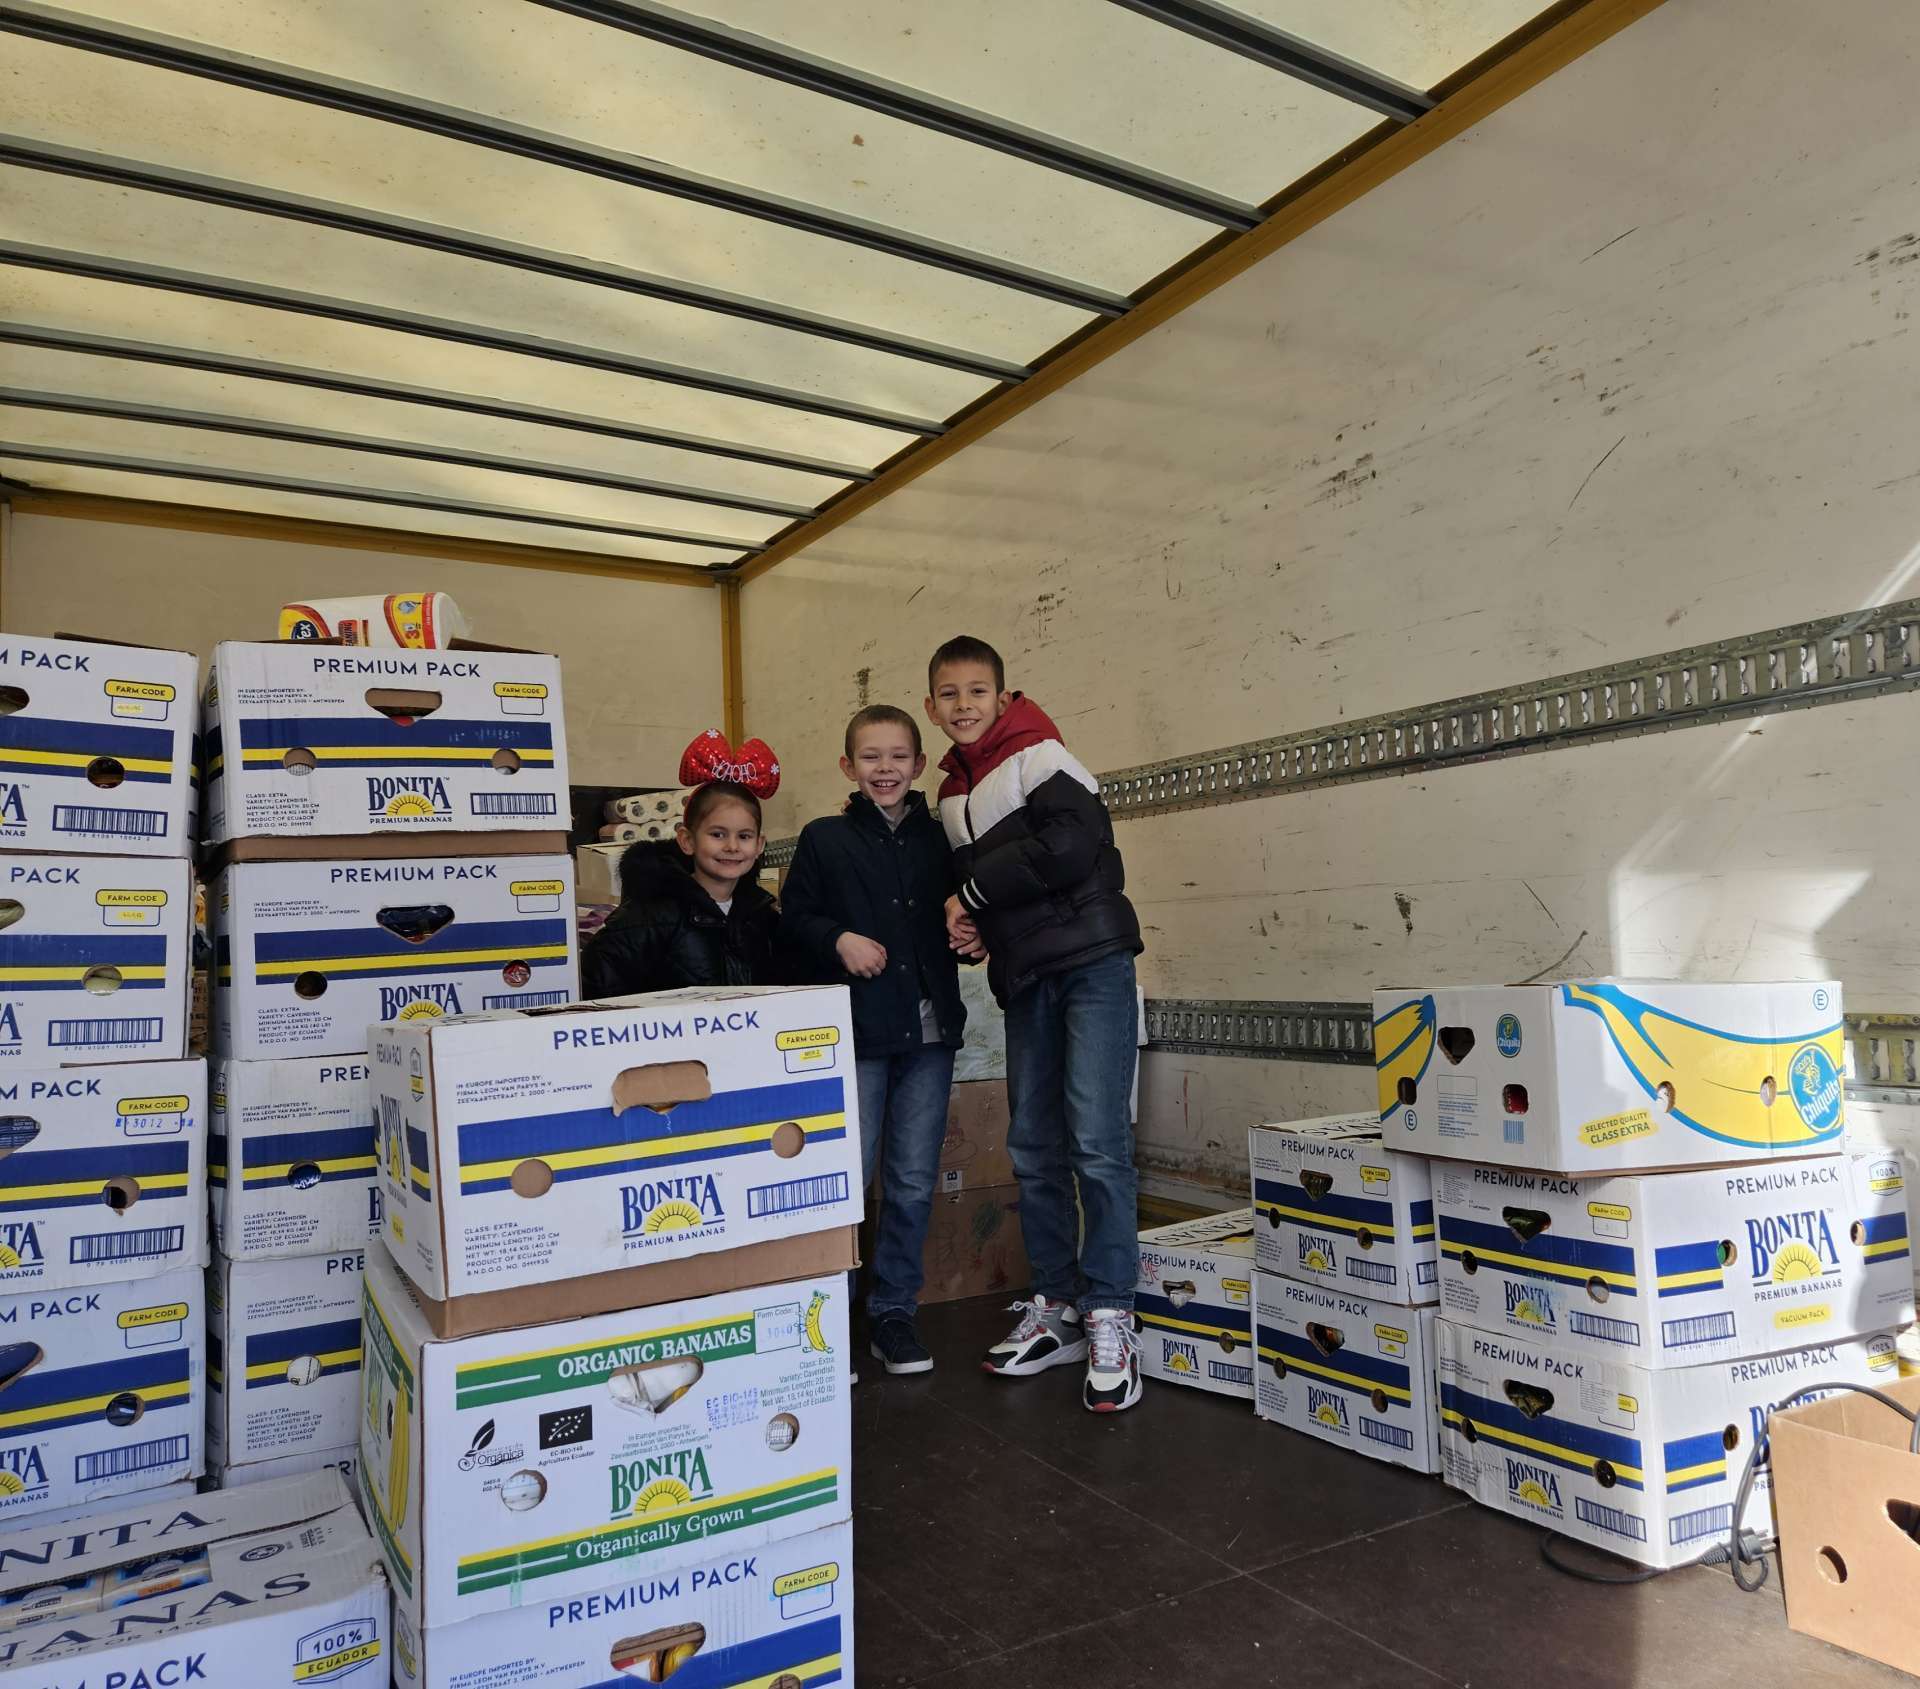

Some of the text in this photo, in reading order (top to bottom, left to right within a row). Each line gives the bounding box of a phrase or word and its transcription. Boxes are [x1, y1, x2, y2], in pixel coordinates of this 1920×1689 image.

[22, 650, 90, 672] PACK
[314, 658, 480, 678] PREMIUM PACK
[116, 686, 166, 696] FARM CODE
[366, 777, 451, 811] BONITA
[11, 867, 80, 884] PACK
[331, 864, 497, 883] PREMIUM PACK
[379, 983, 463, 1021] BONITA
[553, 1010, 760, 1050] PREMIUM PACK
[786, 1033, 830, 1044] FARM CODE
[32, 1079, 101, 1098] PACK
[495, 1076, 530, 1085] IMPORTED
[517, 1083, 539, 1091] PARYS
[553, 1084, 592, 1093] ANTWERPEN
[129, 1101, 179, 1111] FARM CODE
[1800, 1080, 1841, 1124] Chiquita
[1585, 1112, 1648, 1133] SELECTED QUALITY
[1590, 1122, 1650, 1144] CLASS EXTRA
[1282, 1139, 1355, 1160] PREMIUM PACK
[1474, 1169, 1579, 1196] PREMIUM PACK
[1727, 1167, 1839, 1196] PREMIUM PACK
[620, 1174, 725, 1233] BONITA
[494, 1222, 518, 1230] EXTRA
[502, 1226, 544, 1237] CAVENDISH
[465, 1242, 500, 1251] MINIMUM
[624, 1226, 726, 1250] PREMIUM BANANAS
[1745, 1209, 1840, 1278] BONITA
[467, 1257, 502, 1268] PRODUCT
[517, 1250, 552, 1260] ECUADOR
[1298, 1233, 1336, 1267] BONITA
[1142, 1252, 1216, 1273] PREMIUM PACK
[1504, 1280, 1556, 1323] BONITA
[1754, 1278, 1842, 1303] PREMIUM BANANAS
[31, 1294, 100, 1320] PACK
[1286, 1287, 1368, 1318] PREMIUM PACK
[129, 1309, 178, 1322] FARM CODE
[1780, 1310, 1825, 1324] VACUUM PACK
[558, 1325, 752, 1379] ORGANIC BANANAS
[1162, 1339, 1199, 1370] BONITA
[1474, 1340, 1584, 1378] PREMIUM PACK
[803, 1366, 835, 1378] Cavendish
[1731, 1347, 1838, 1383] PREMIUM PACK
[1308, 1386, 1349, 1426] BONITA
[538, 1450, 595, 1466] Agricultura Ecuador
[609, 1447, 713, 1514] BONITA
[1506, 1458, 1563, 1507] BONITA
[576, 1507, 744, 1559] Organically Grown
[783, 1570, 830, 1588] FARM CODE
[550, 1557, 758, 1628] PREMIUM PACK
[313, 1629, 362, 1655] 100%
[107, 1653, 206, 1689] PACK
[308, 1647, 369, 1675] ECUADOR
[459, 1662, 524, 1680] EUROPE IMPORTED
[510, 1666, 532, 1677] PARYS
[546, 1660, 585, 1675] ANTWERPEN
